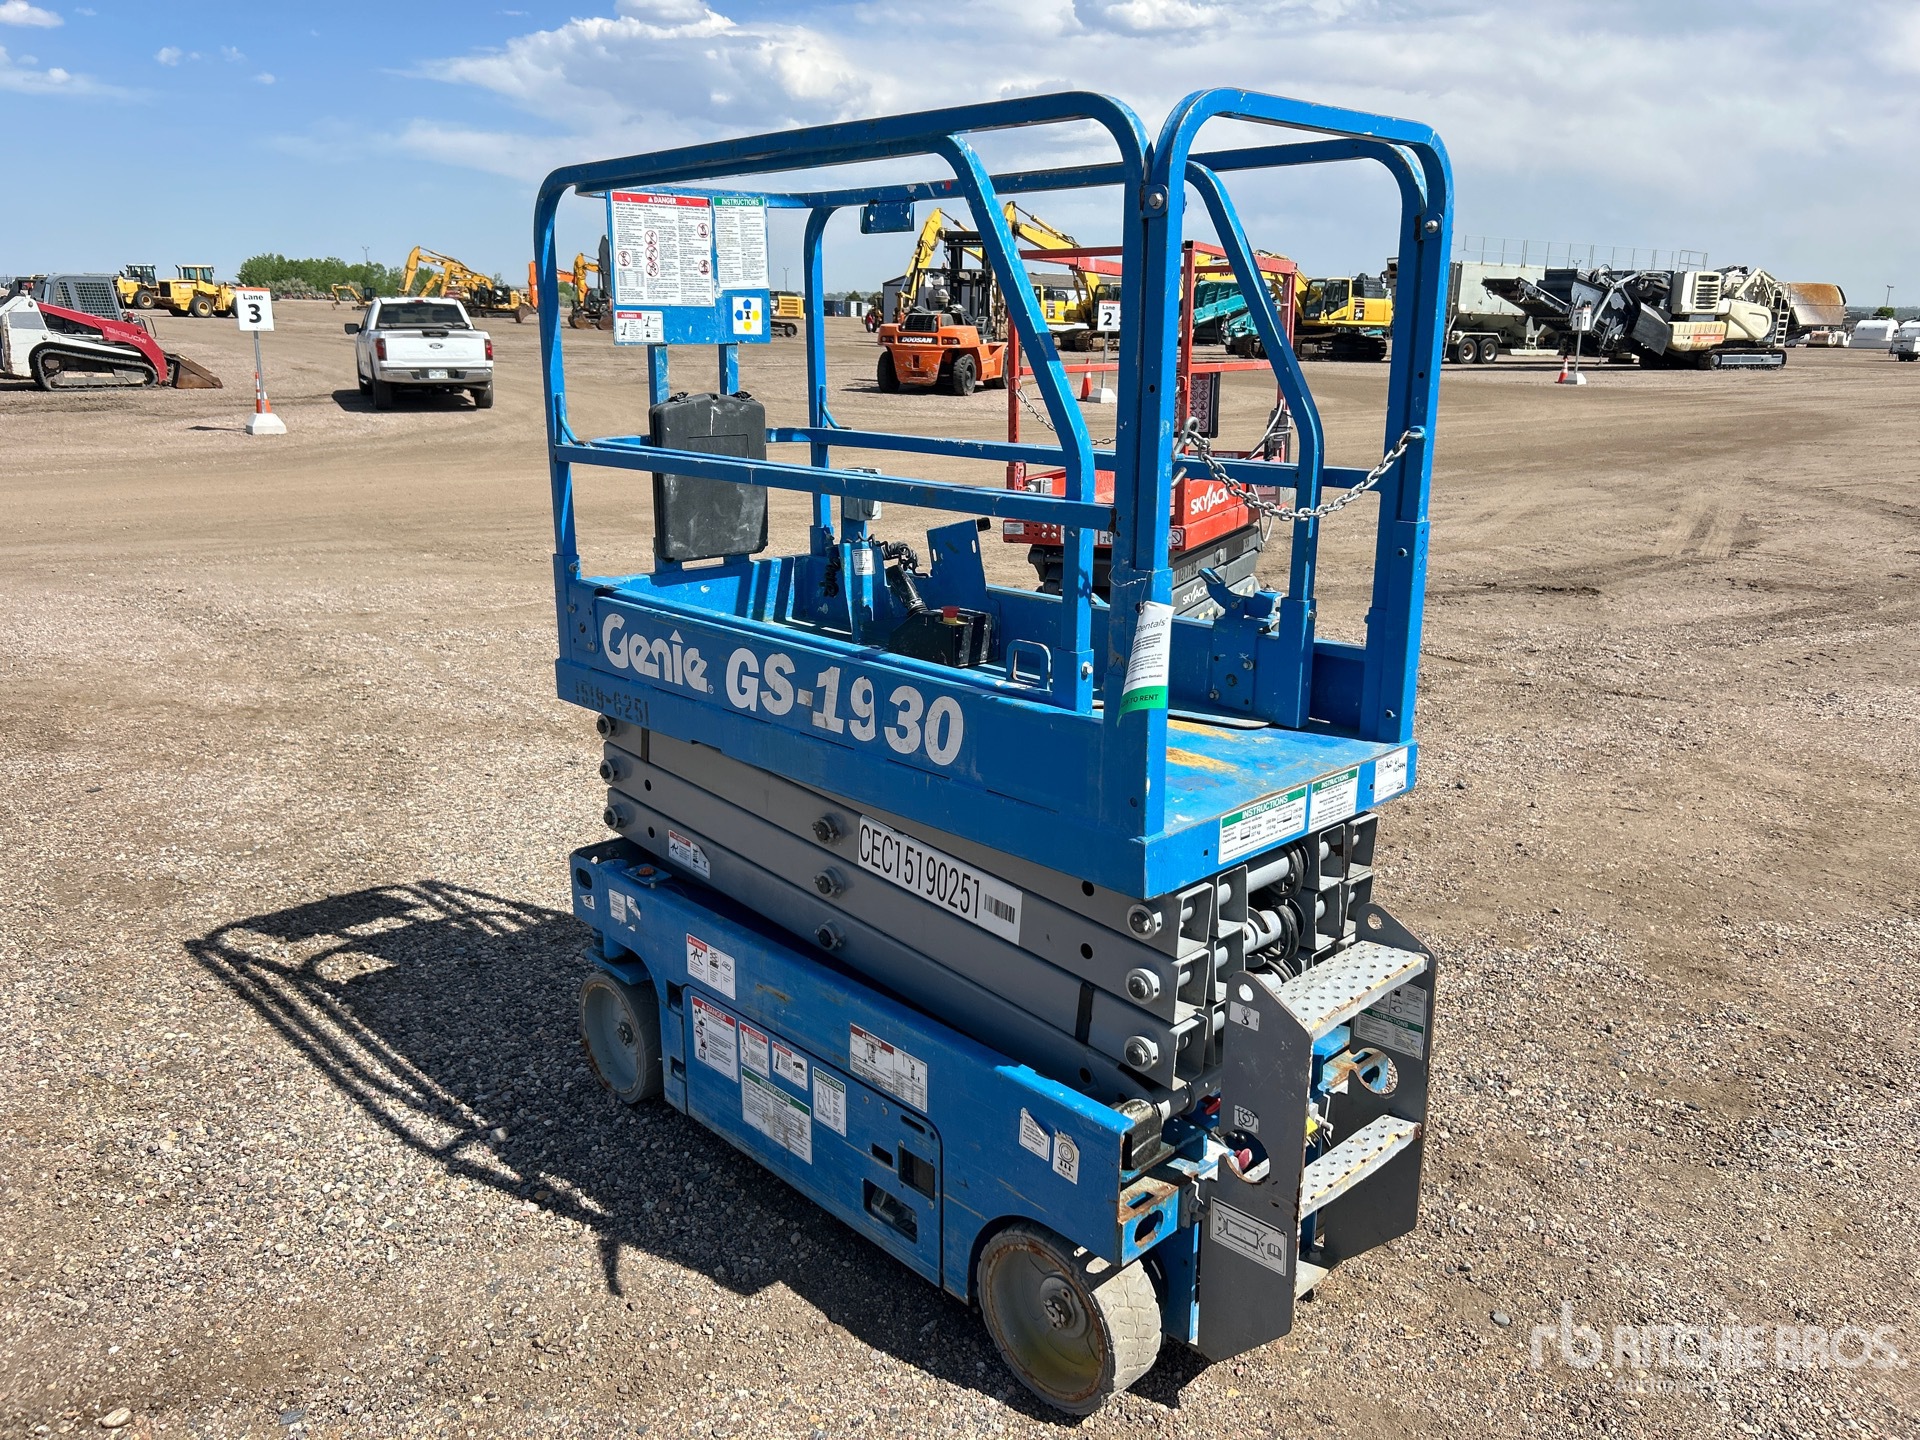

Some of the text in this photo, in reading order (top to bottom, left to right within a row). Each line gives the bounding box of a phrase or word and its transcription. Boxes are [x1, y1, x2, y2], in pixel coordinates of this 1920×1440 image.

[653, 196, 677, 204] DANGER
[721, 198, 760, 206] INSTRUCTIONS
[243, 293, 264, 301] Lane
[248, 303, 263, 323] 3
[1103, 312, 1113, 326] 2
[1575, 316, 1580, 327] 1
[105, 326, 147, 344] TAKEUCHI
[901, 336, 933, 344] DOOSAN
[1190, 483, 1229, 515] SKYJACK
[602, 613, 708, 693] Genie
[726, 647, 964, 766] GS-1930
[1140, 693, 1159, 702] RENT
[1321, 773, 1349, 788] INSTRUCTIONS
[1242, 795, 1289, 819] INSTRUCTIONS
[859, 824, 980, 919] CEC15190251
[706, 1004, 728, 1022] DANGER
[1372, 1011, 1409, 1028] INSTRUCTIONS
[814, 1069, 845, 1093] INSTRUCTIONS
[759, 1080, 792, 1104] INSTRUCTIONS
